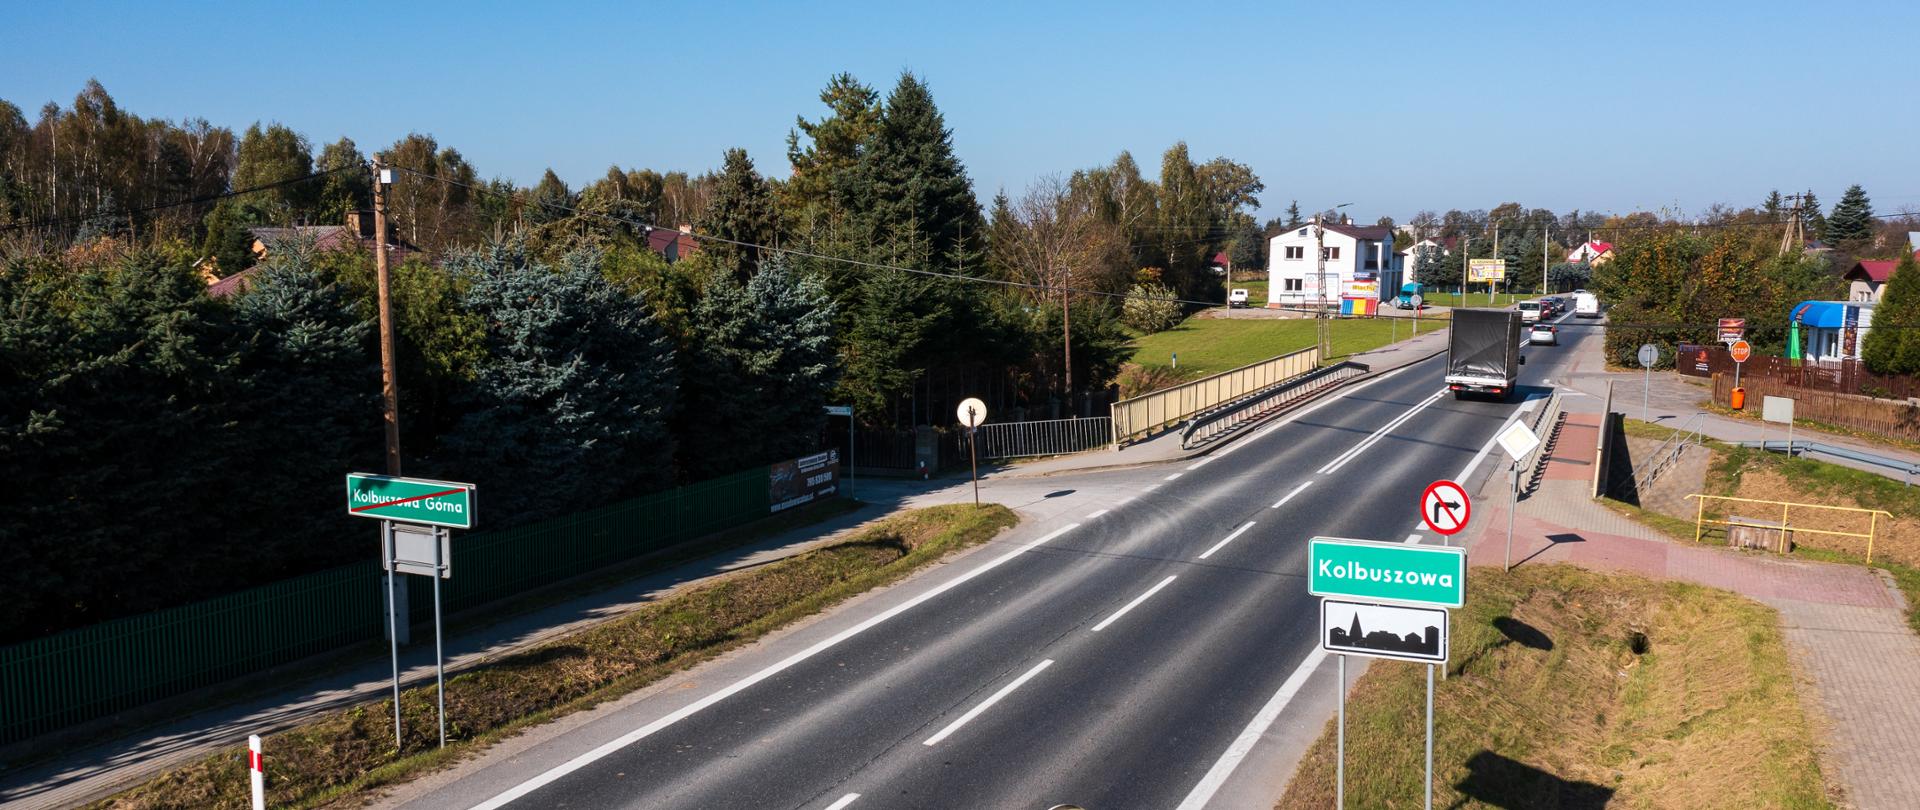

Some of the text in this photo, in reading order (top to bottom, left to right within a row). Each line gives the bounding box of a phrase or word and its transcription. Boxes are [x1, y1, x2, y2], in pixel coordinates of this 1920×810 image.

[1733, 347, 1748, 355] STOP
[353, 489, 463, 513] Kolbuszowa Górna
[1319, 559, 1453, 588] Kolbuszowa
